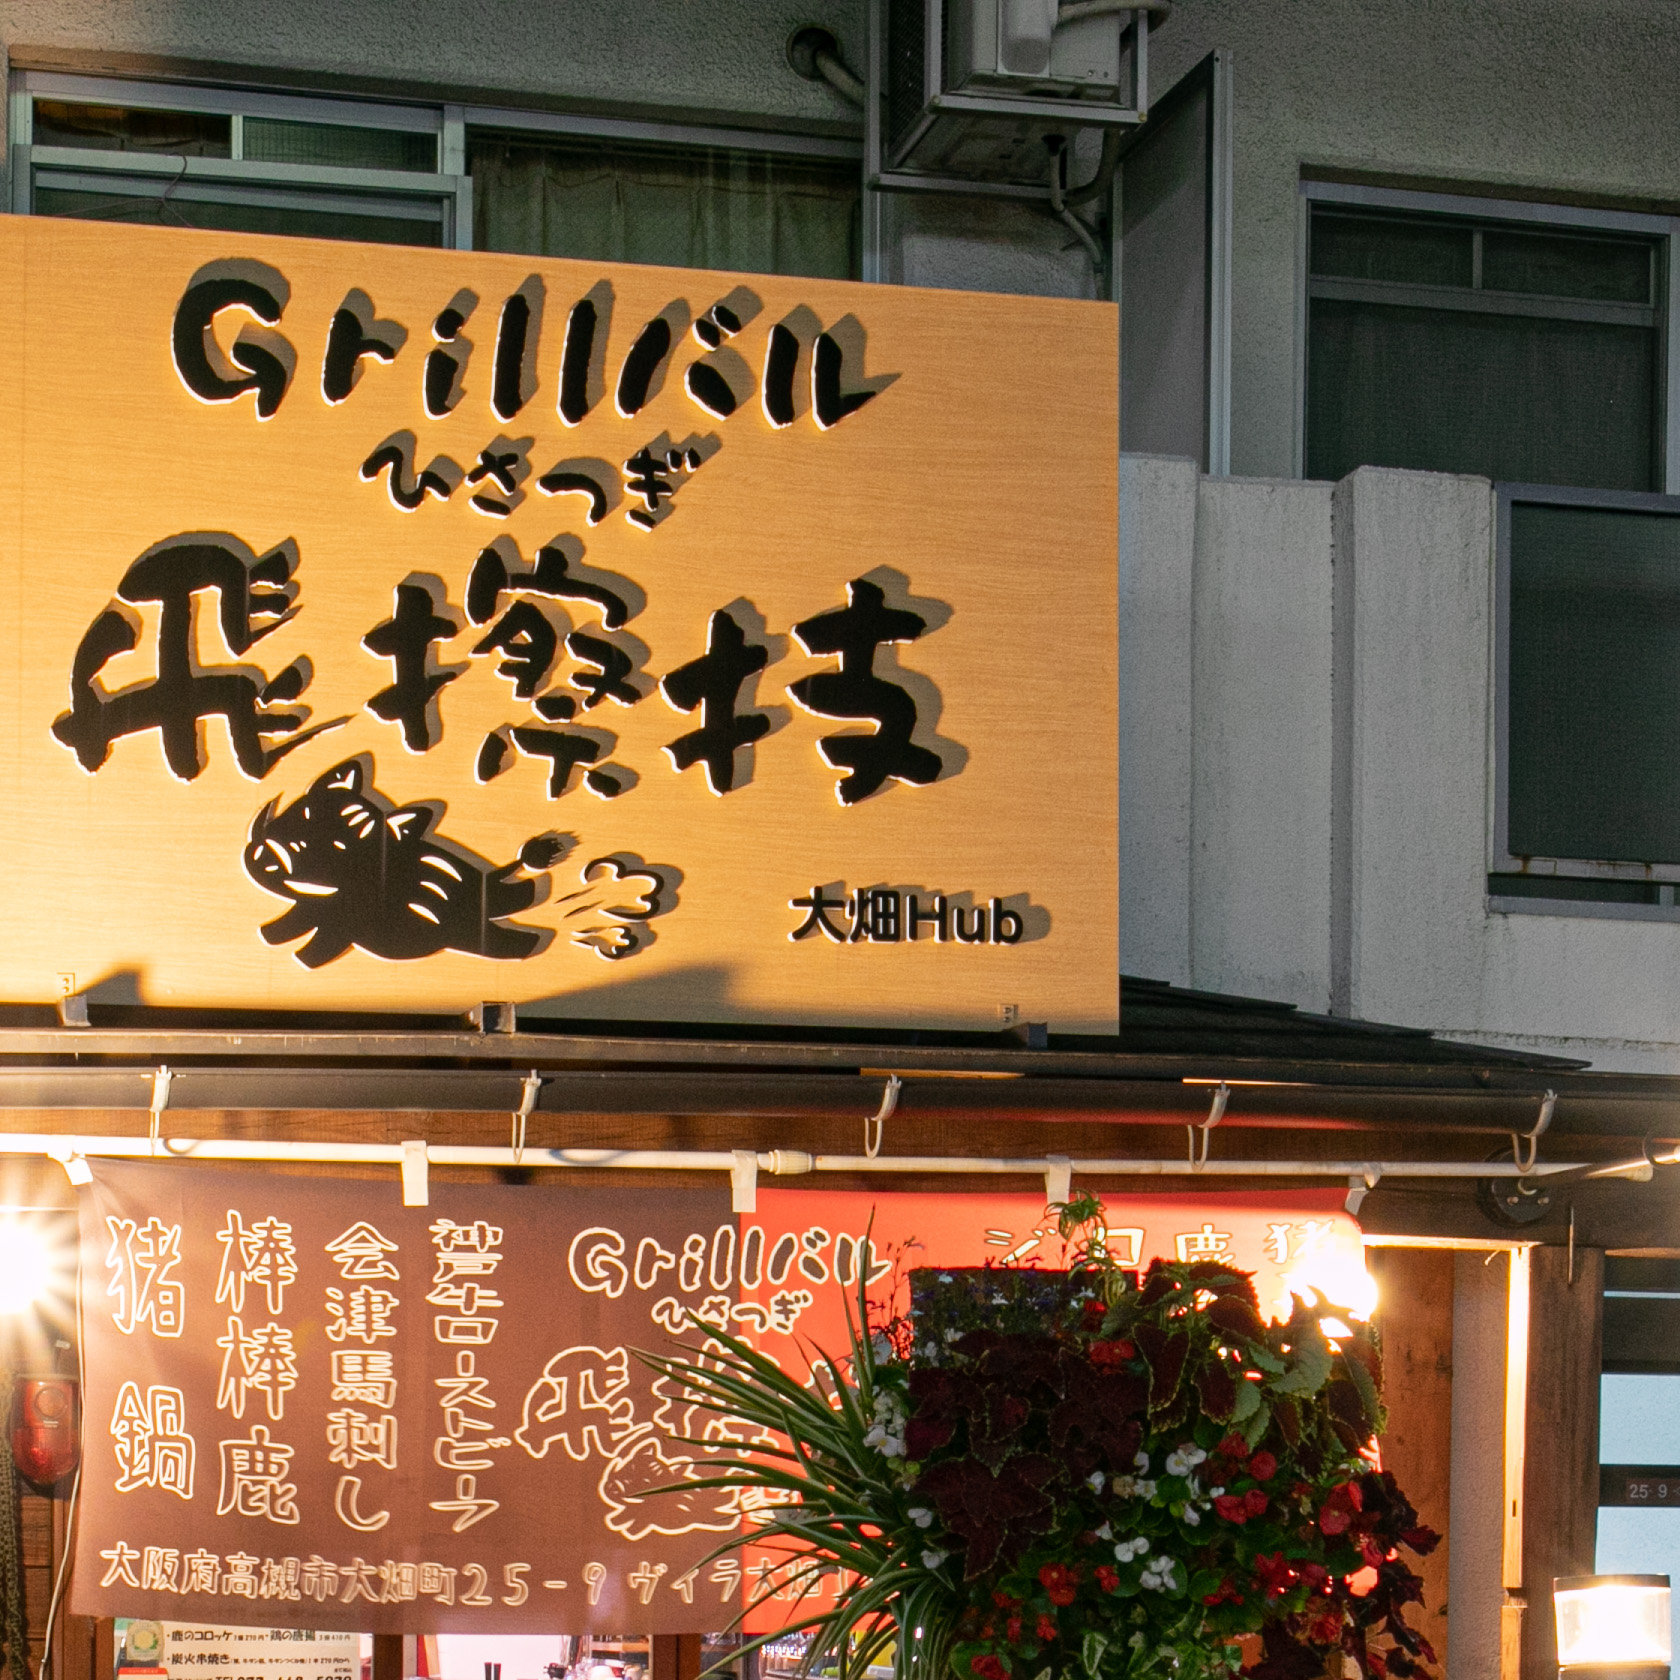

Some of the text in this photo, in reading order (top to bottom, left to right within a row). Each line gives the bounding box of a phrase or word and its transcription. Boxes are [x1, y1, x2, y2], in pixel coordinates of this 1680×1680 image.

[360, 443, 702, 531] ひさつぎ
[790, 887, 1024, 946] 大畑Hub
[215, 1210, 300, 1526] 棒棒鹿
[324, 1221, 400, 1532] 会津馬刺し
[426, 1218, 511, 1532] 神戸牛ローストビーフ
